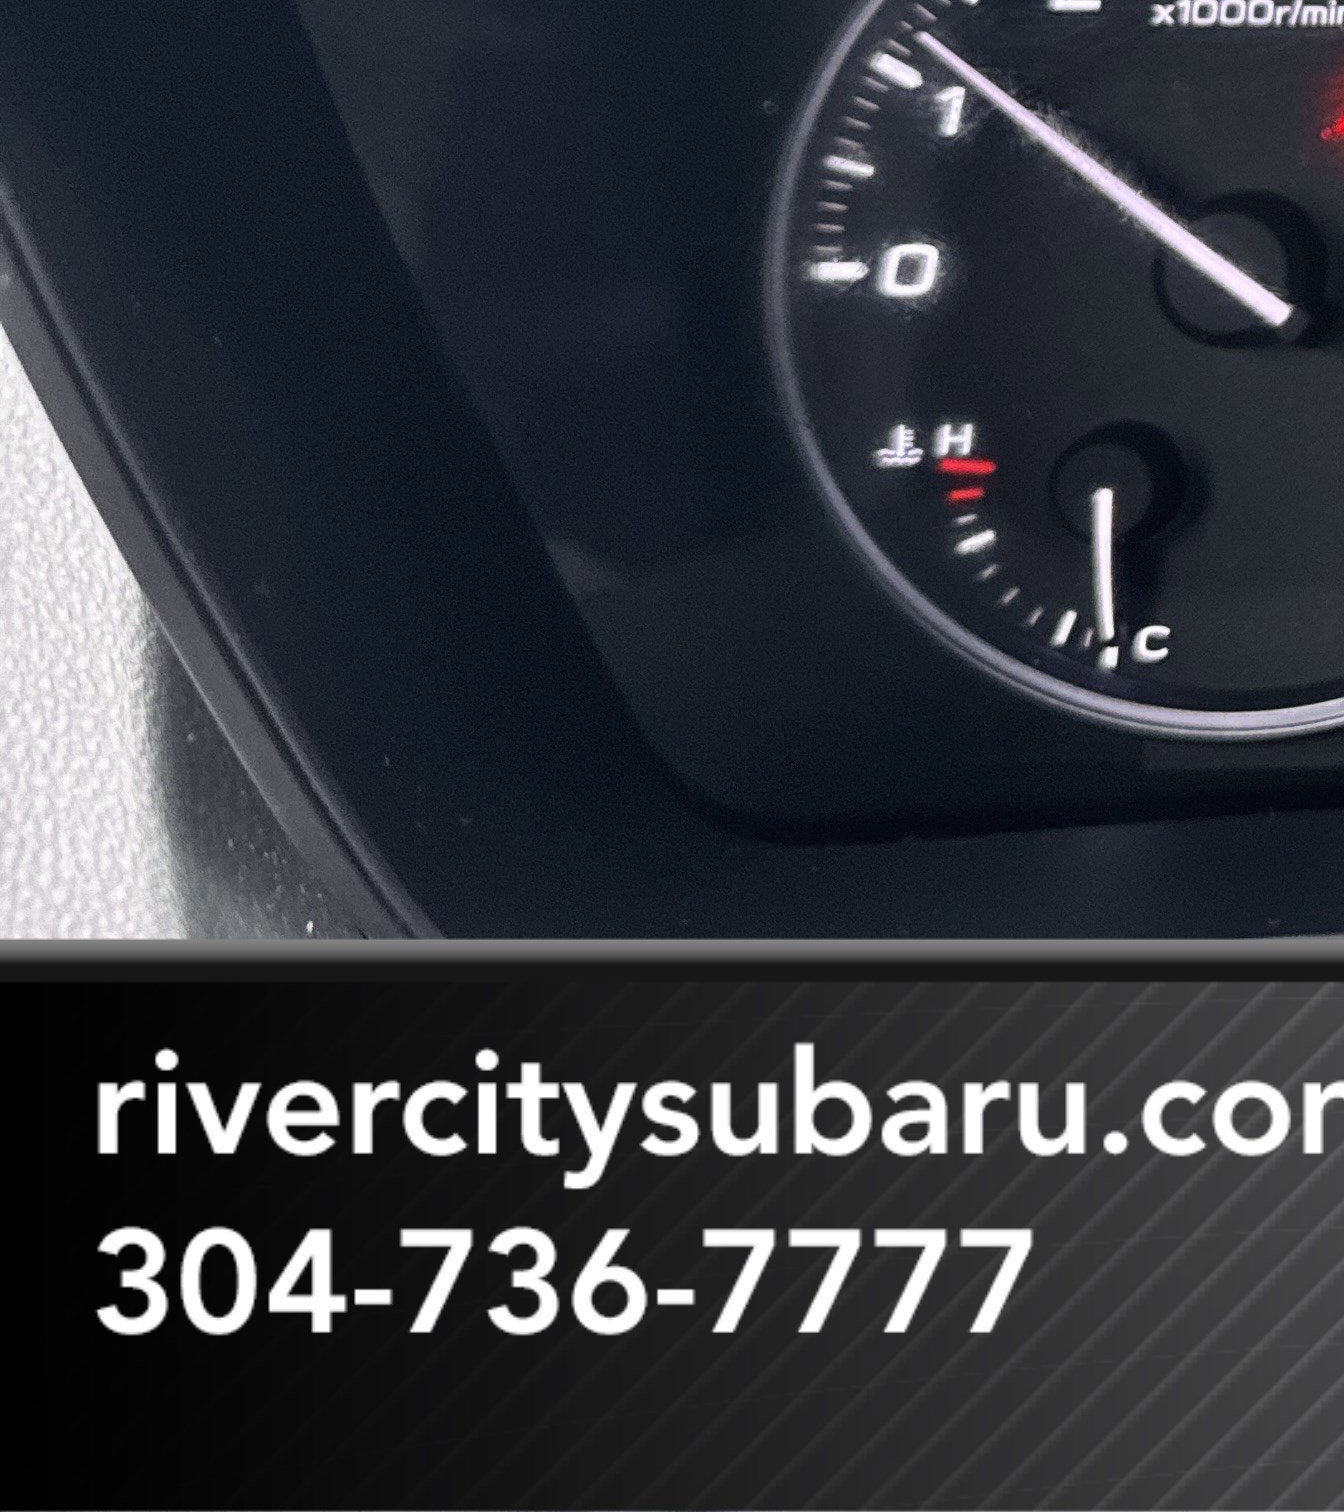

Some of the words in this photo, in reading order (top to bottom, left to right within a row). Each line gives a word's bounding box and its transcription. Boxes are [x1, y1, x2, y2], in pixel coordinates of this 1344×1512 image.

[936, 87, 965, 136] 1
[878, 243, 939, 297] 0
[936, 424, 975, 455] H
[1133, 626, 1170, 661] C
